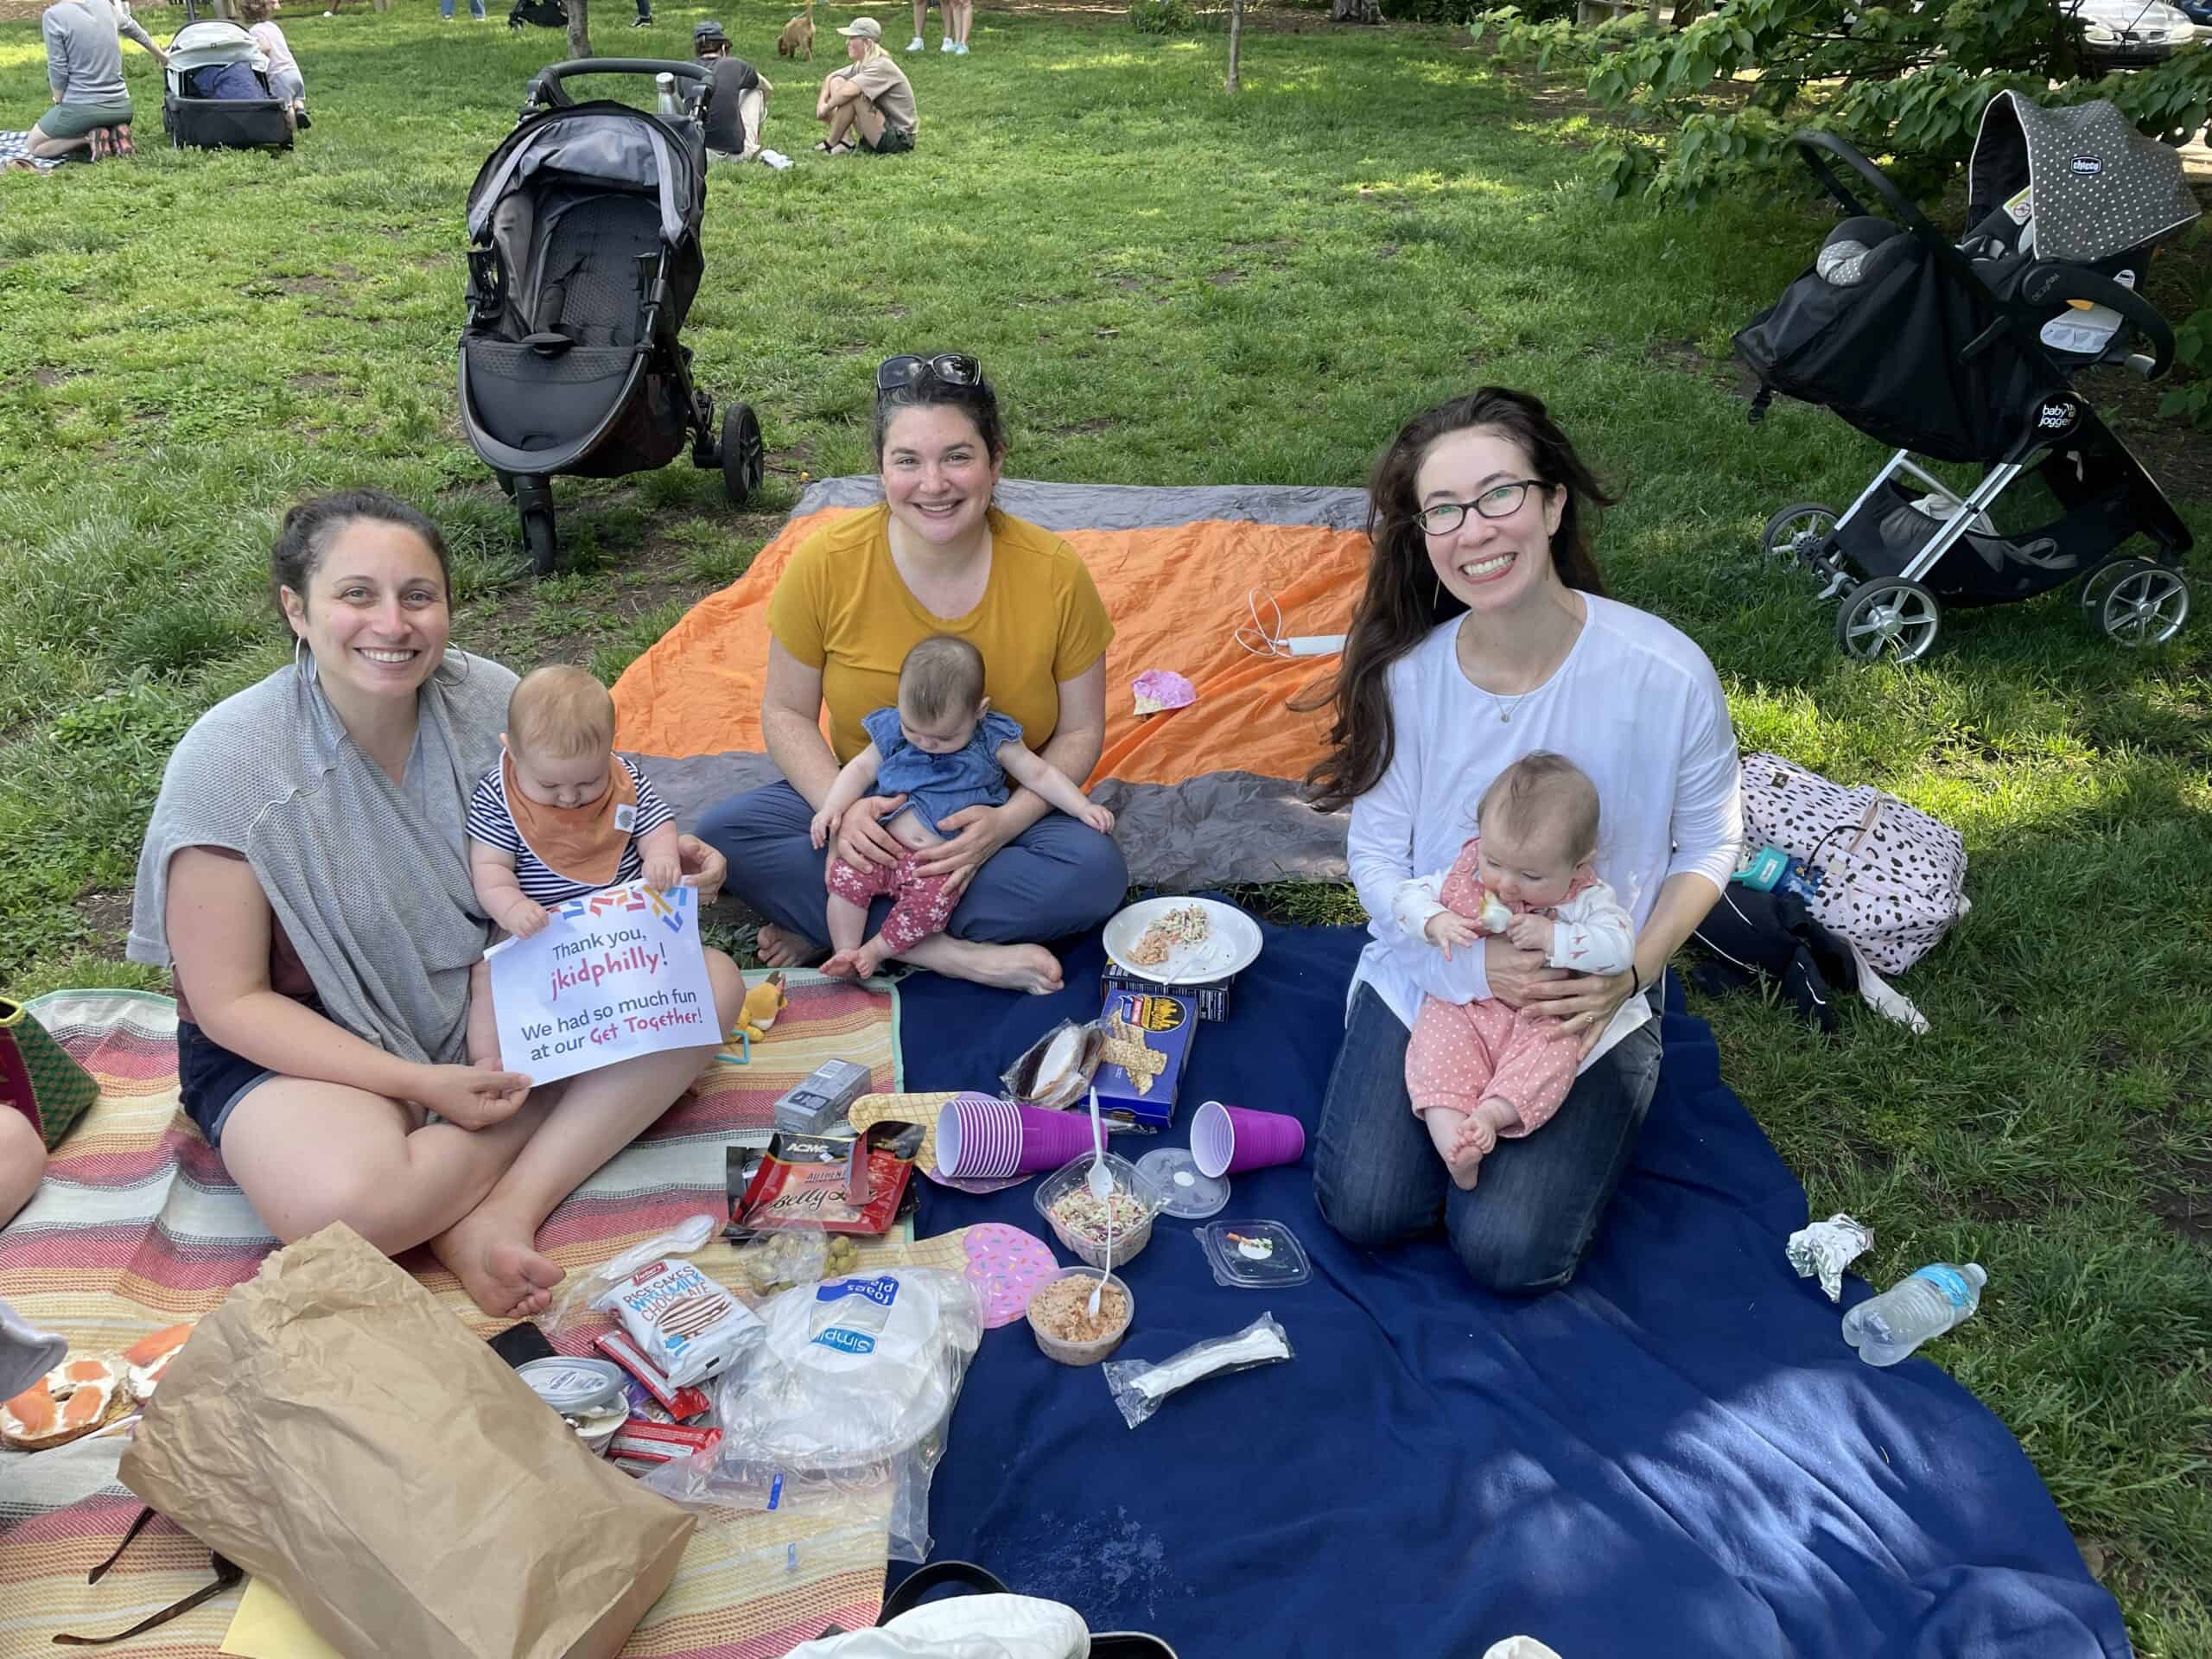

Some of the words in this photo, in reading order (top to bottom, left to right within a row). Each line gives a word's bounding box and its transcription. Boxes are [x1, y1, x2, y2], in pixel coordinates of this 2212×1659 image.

[2074, 160, 2099, 170] chicco
[2037, 415, 2071, 428] jogger
[2043, 404, 2067, 418] baby
[552, 938, 604, 961] Thank
[607, 927, 647, 948] you,
[550, 943, 669, 1001] jkidphilly!
[521, 1022, 553, 1042] We
[556, 1010, 590, 1033] had
[593, 1005, 614, 1021] so
[619, 991, 670, 1014] much
[671, 988, 697, 1006] fun
[531, 1043, 550, 1061] at
[555, 1035, 586, 1054] our
[589, 1025, 619, 1046] Get
[785, 1143, 830, 1154] ACME
[767, 1188, 826, 1211] Belly
[623, 1285, 652, 1303] RICE
[652, 1266, 696, 1289] CAKES
[817, 1330, 871, 1351] Simpl
